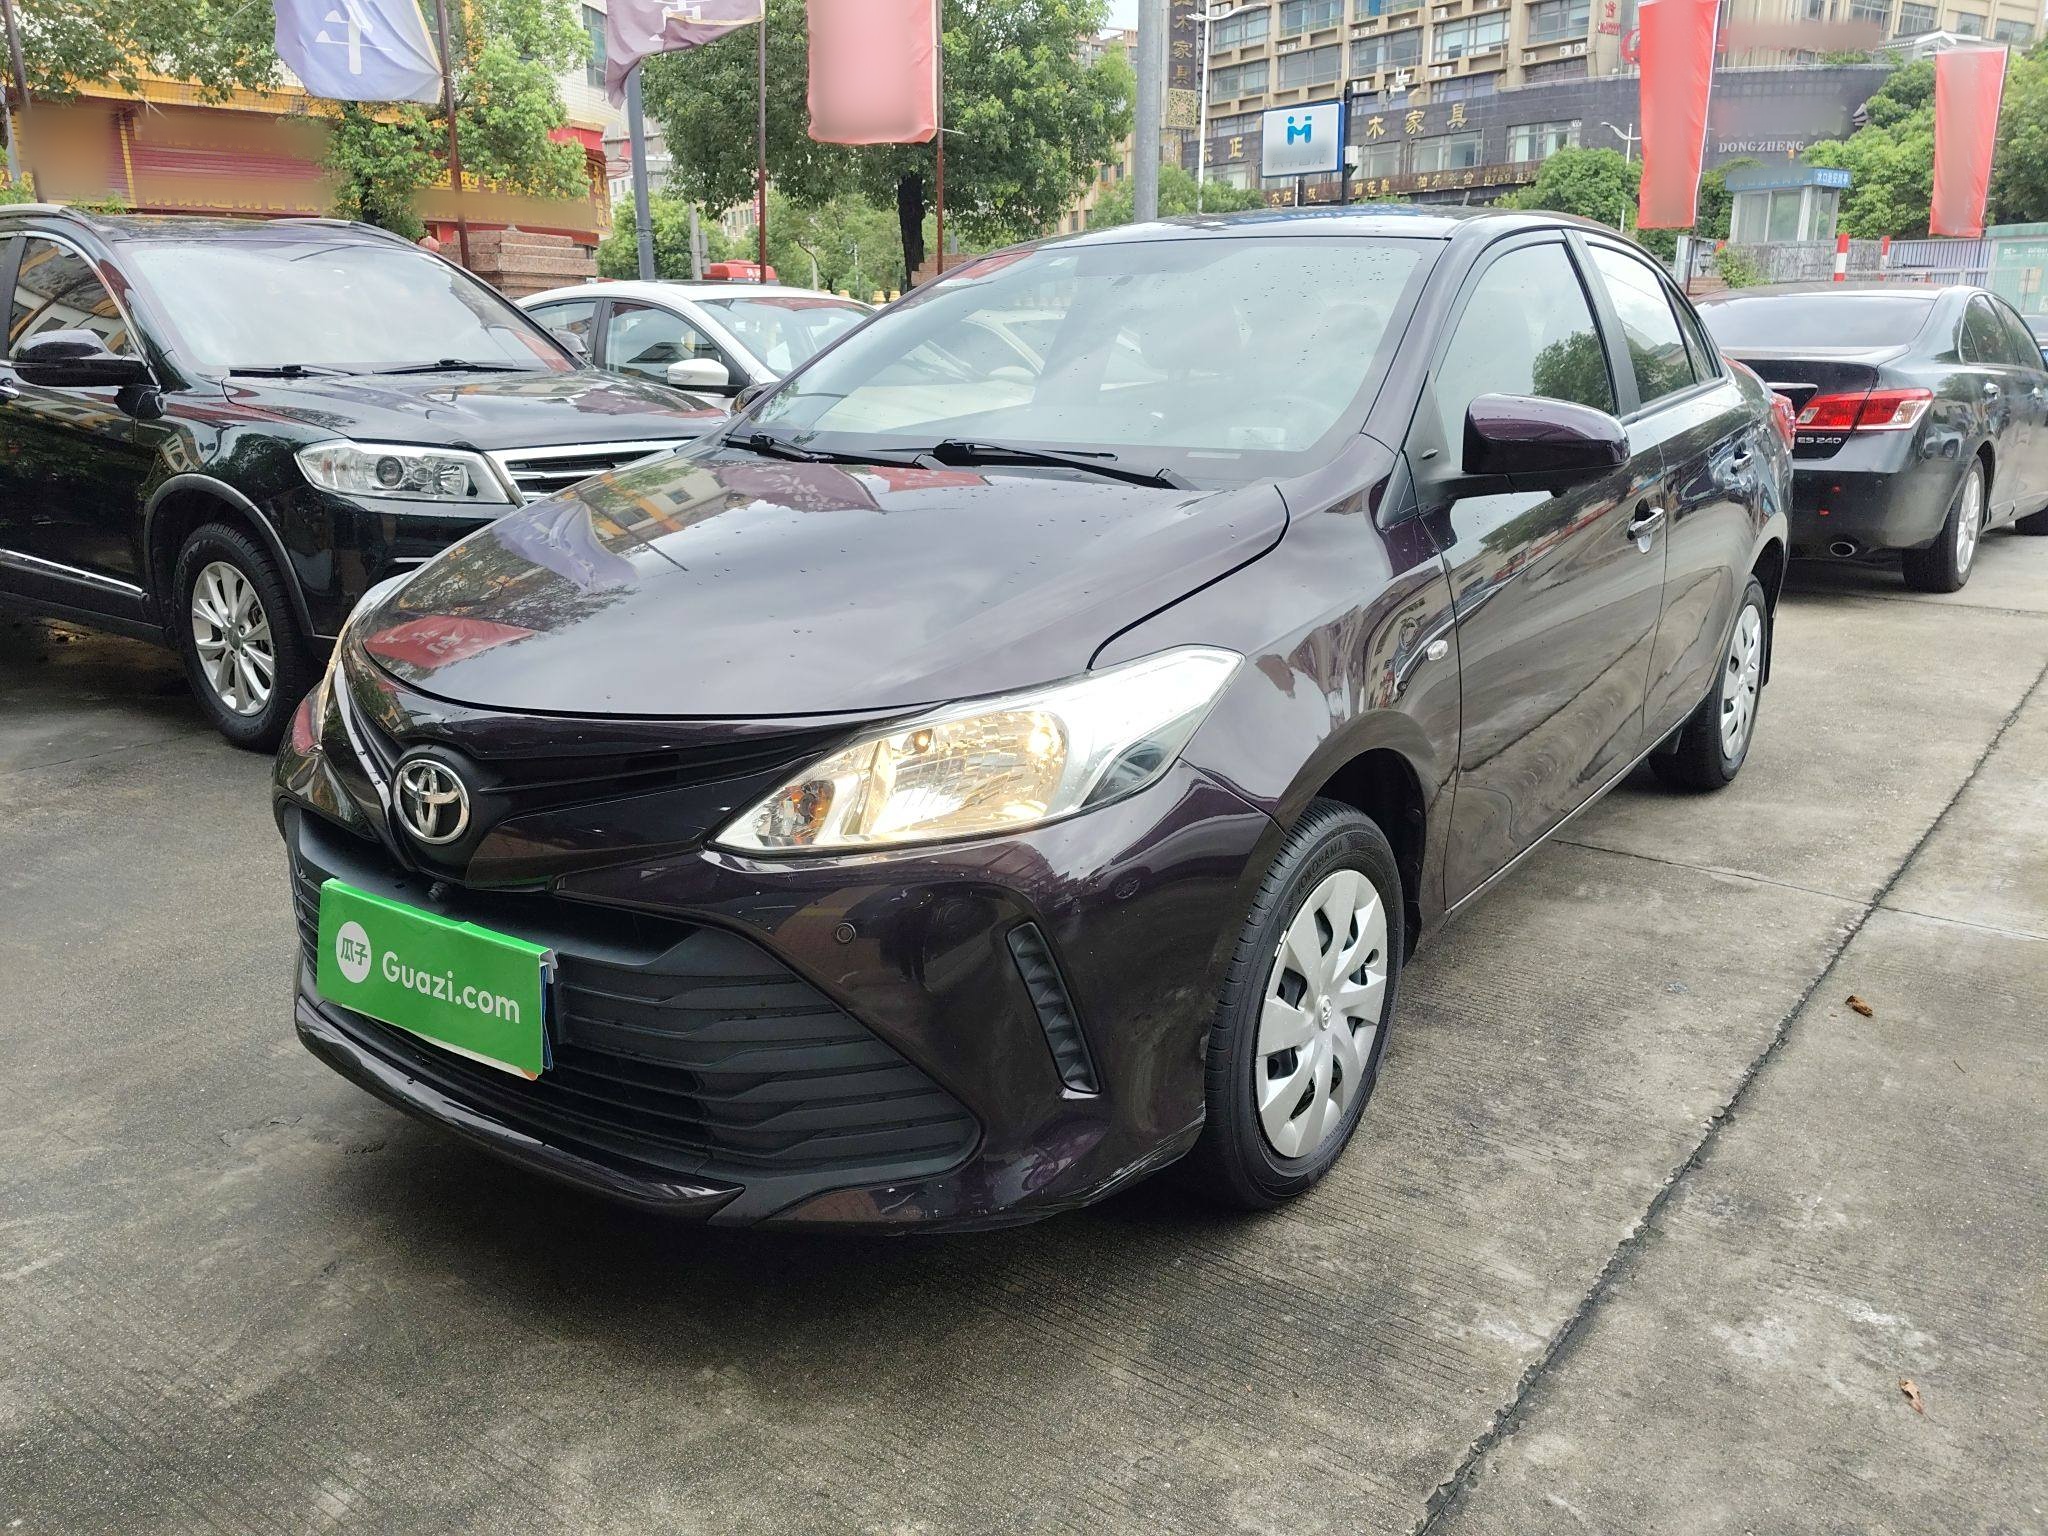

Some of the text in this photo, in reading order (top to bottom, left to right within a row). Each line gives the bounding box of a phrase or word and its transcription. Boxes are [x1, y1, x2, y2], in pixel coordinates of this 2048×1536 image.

[1173, 0, 1193, 84] 木家具
[1718, 140, 1805, 153] DONGZHENG
[1797, 436, 1842, 444] ES 240
[341, 937, 368, 966] 瓜子
[382, 951, 520, 1024] Guazi.com
